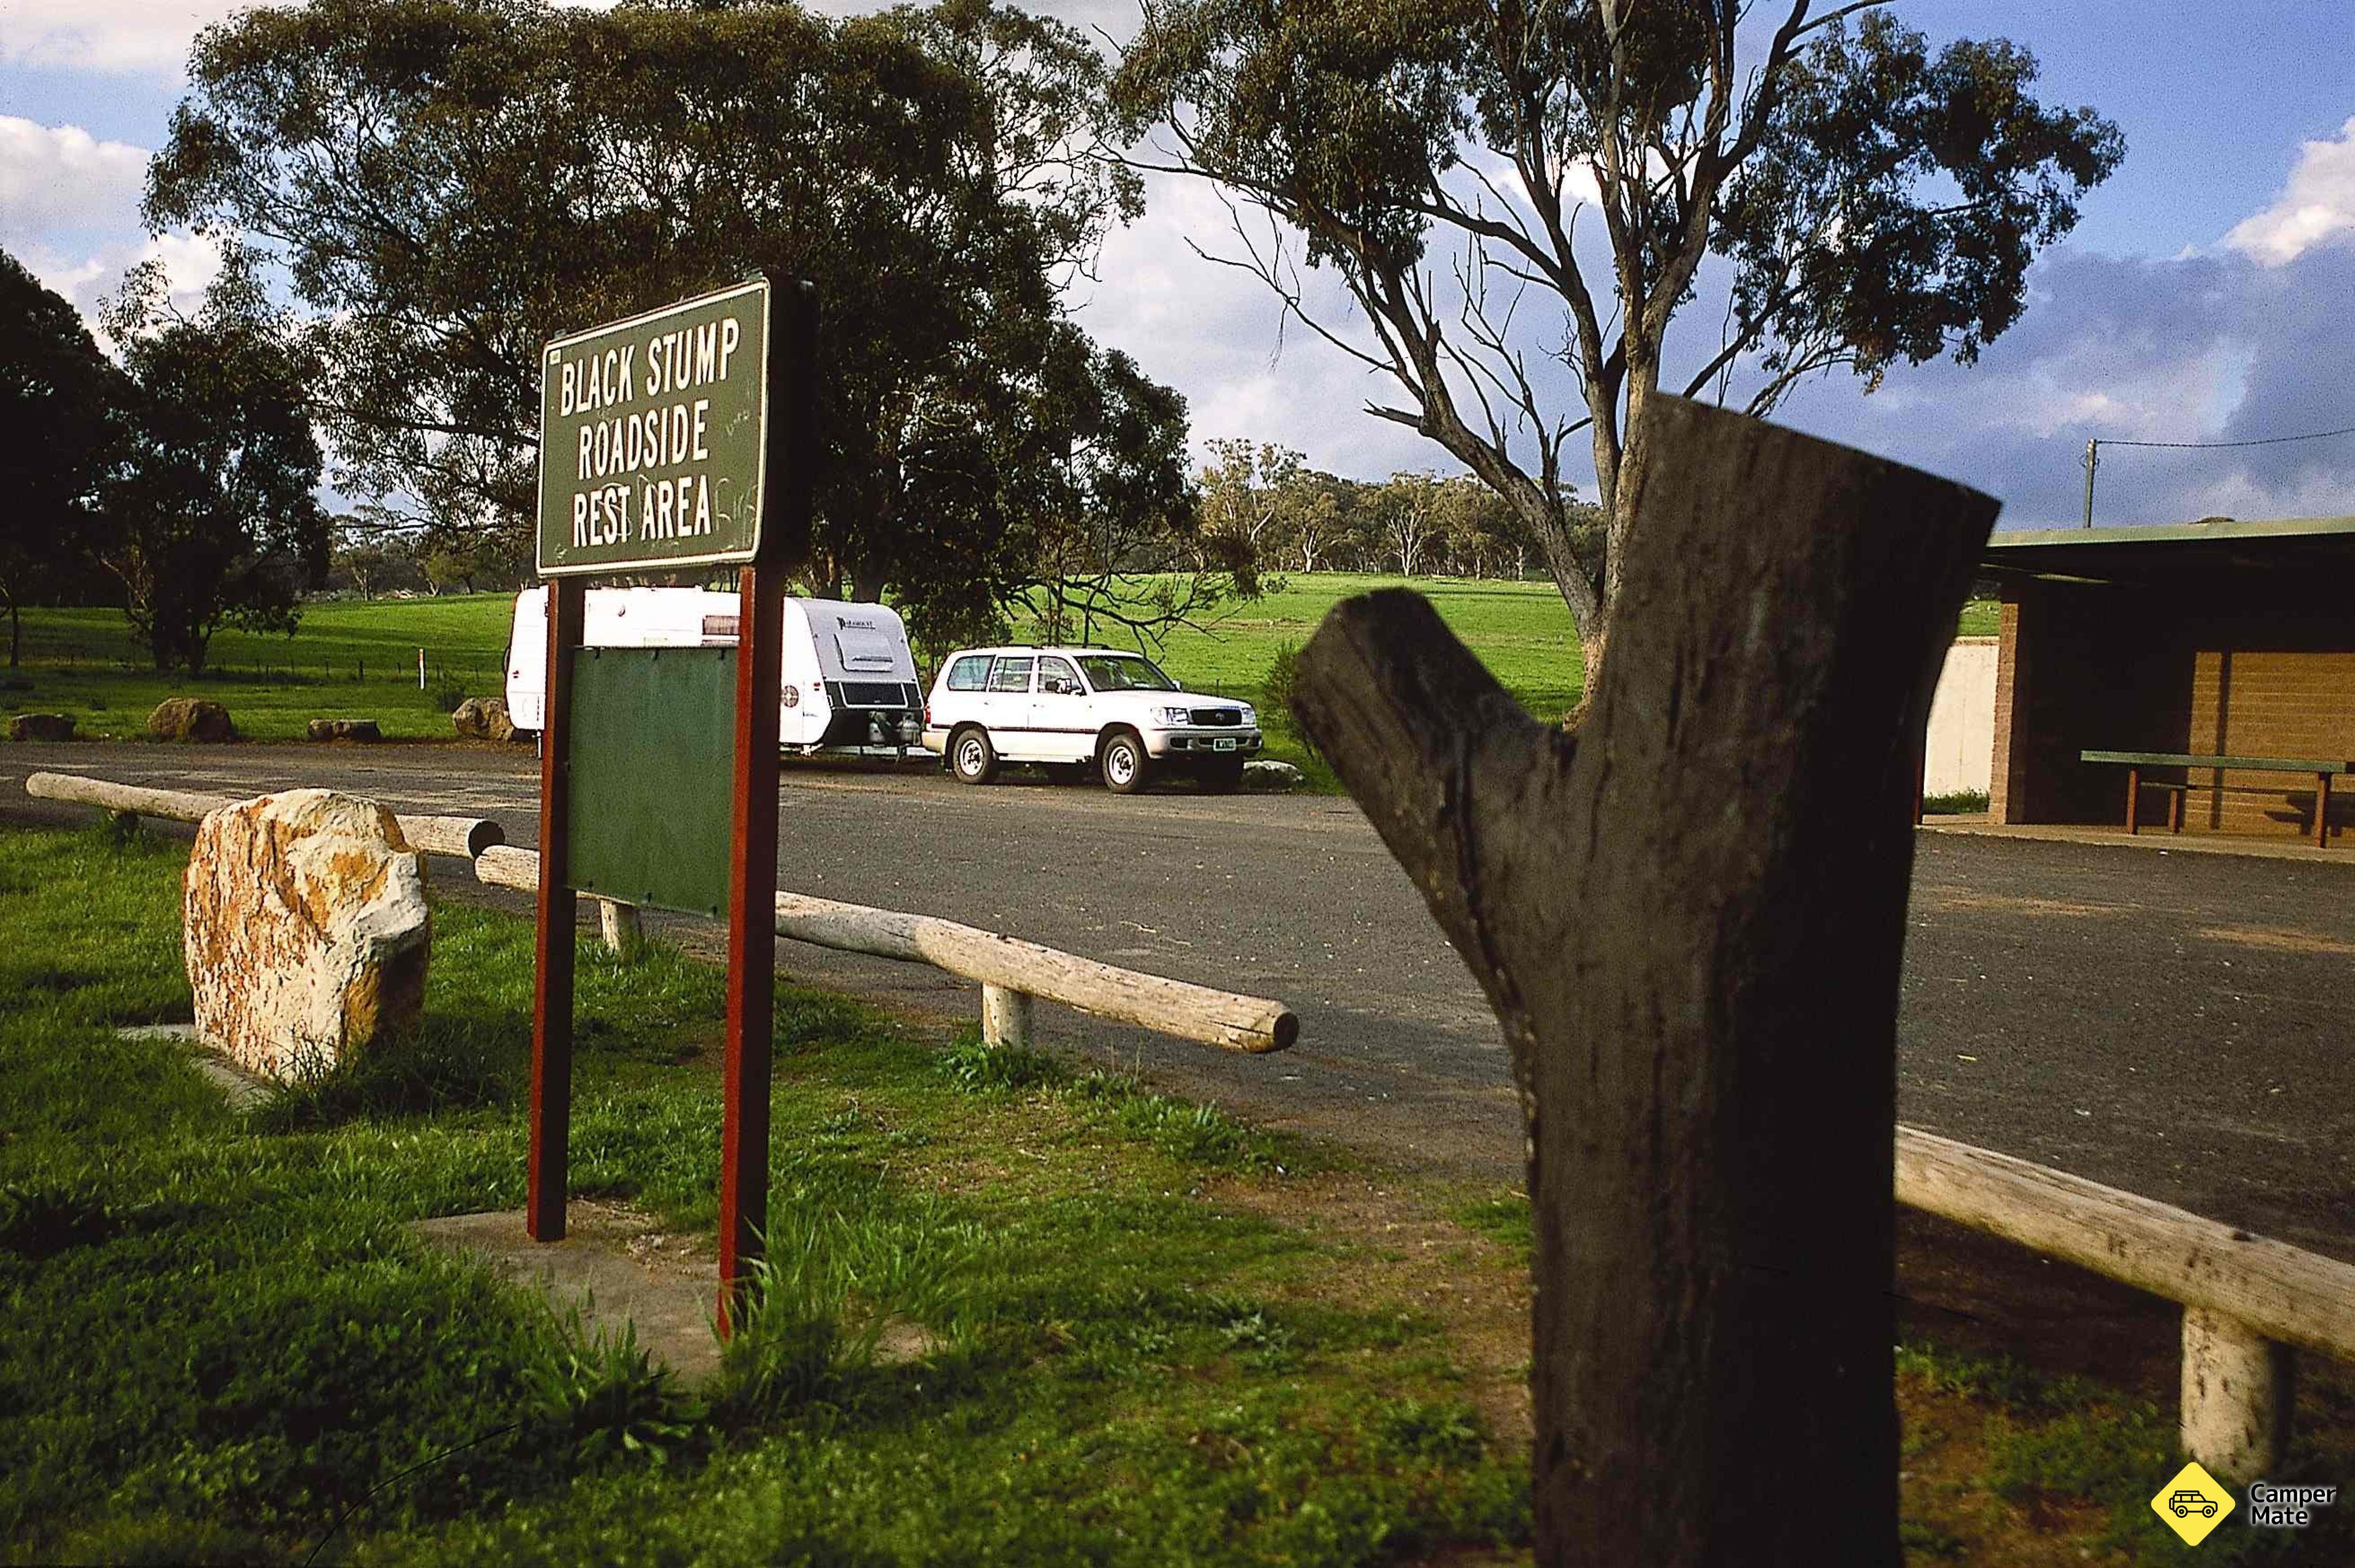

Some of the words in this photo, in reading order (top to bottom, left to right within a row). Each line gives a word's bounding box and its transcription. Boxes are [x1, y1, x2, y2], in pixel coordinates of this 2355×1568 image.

[560, 345, 635, 417] BLACK
[646, 317, 740, 397] STUMP
[578, 399, 710, 480] ROADSIDE
[573, 486, 632, 548] REST
[641, 474, 711, 541] AREA
